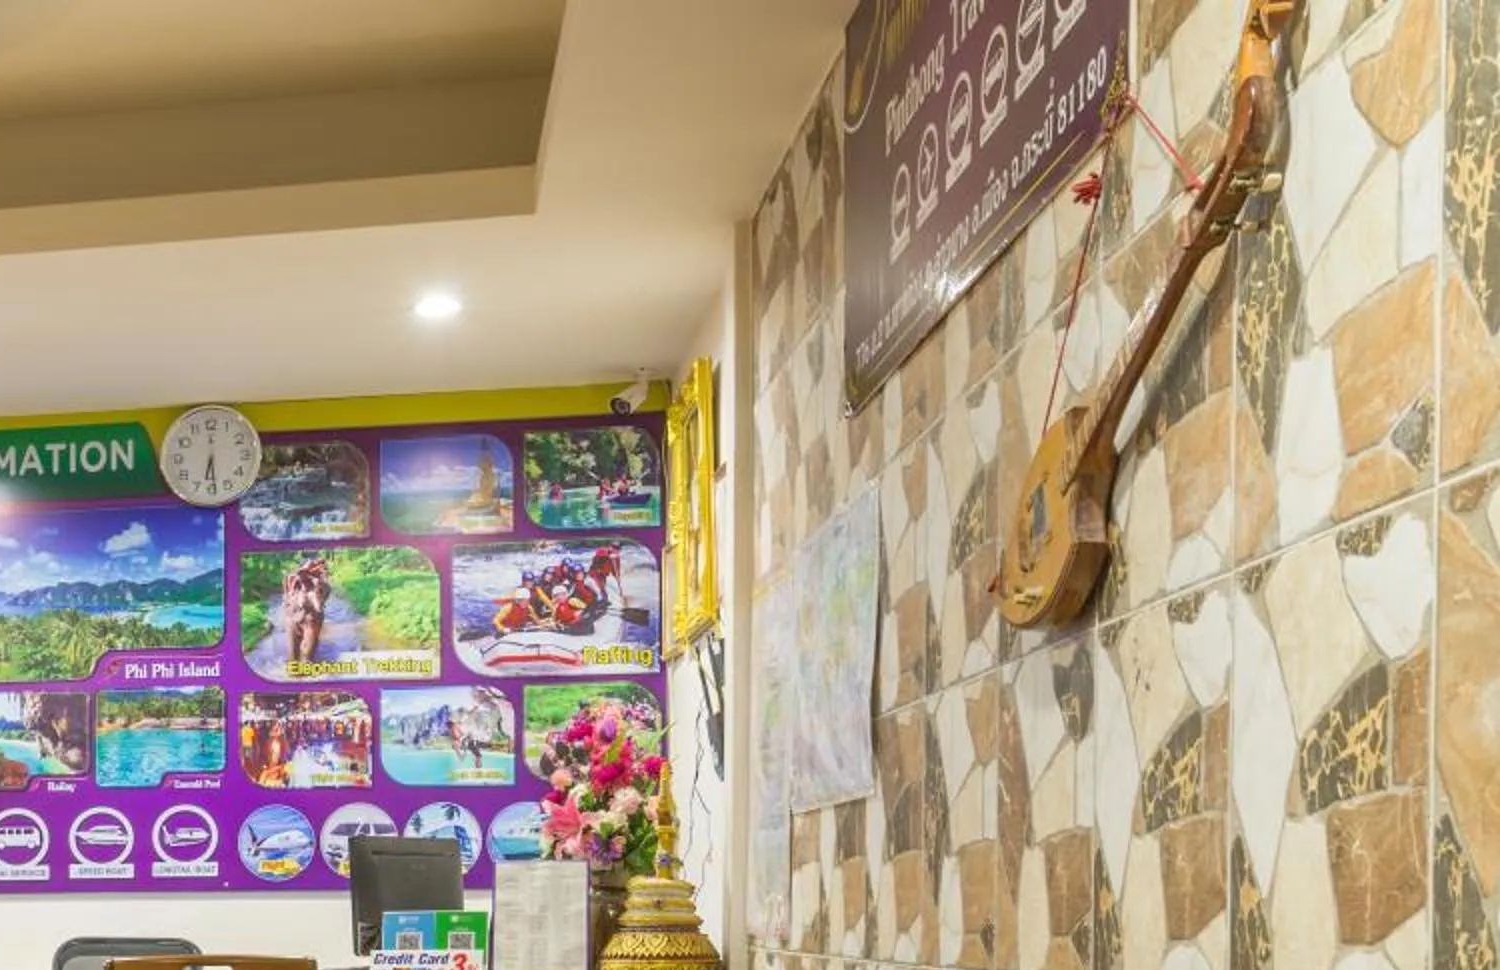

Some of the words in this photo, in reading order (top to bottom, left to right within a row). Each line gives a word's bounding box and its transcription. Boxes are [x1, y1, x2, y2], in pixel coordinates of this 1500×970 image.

[1056, 45, 1107, 136] 81180
[582, 645, 654, 668] Rafting
[125, 662, 147, 679] Phi
[152, 662, 174, 679] Phi
[179, 660, 220, 678] Island
[288, 659, 357, 678] Elephant
[363, 657, 433, 677] Trekking
[373, 952, 414, 965] Credit
[418, 952, 451, 965] Card
